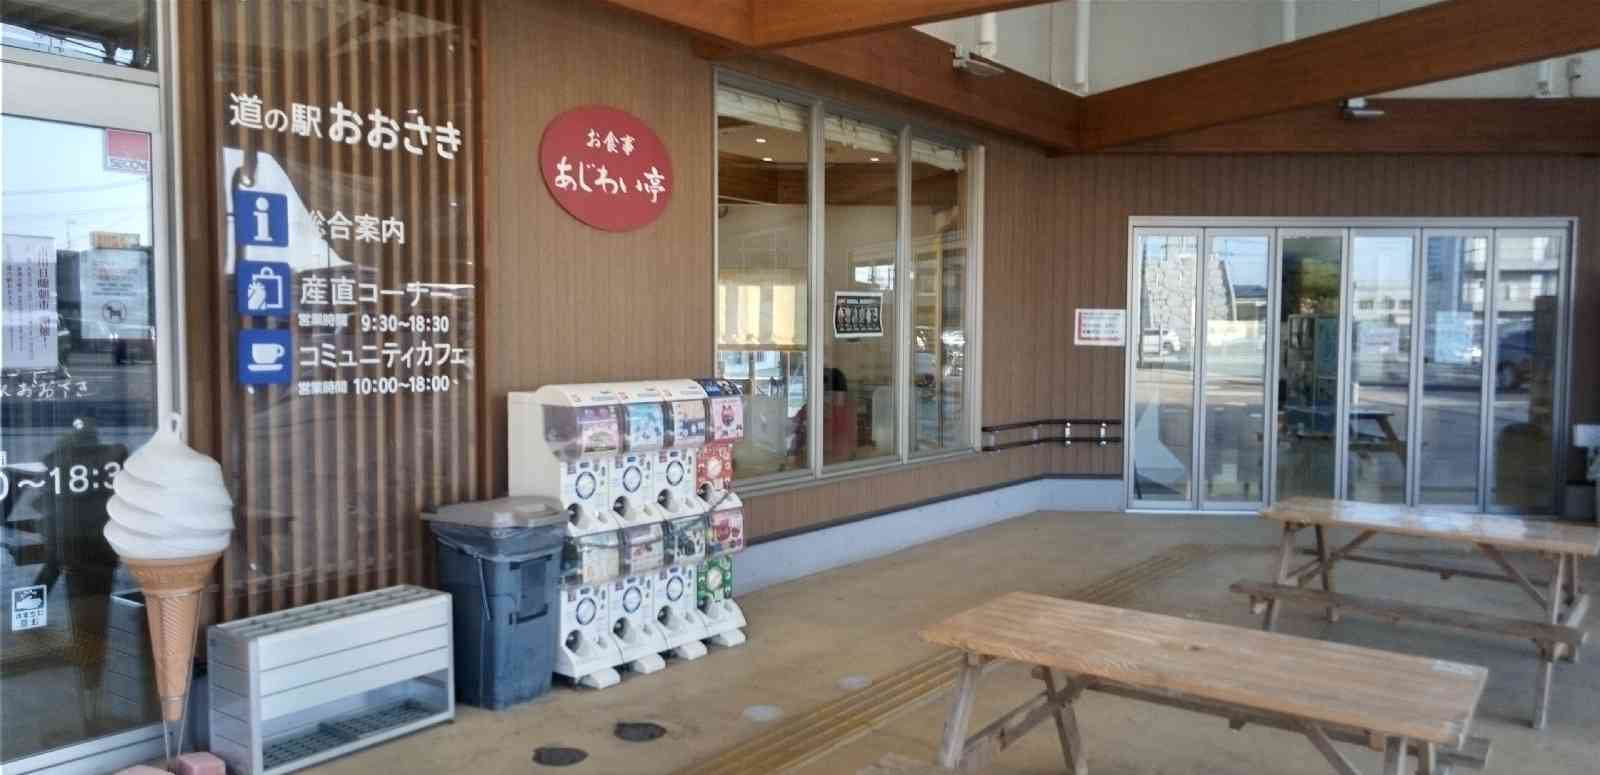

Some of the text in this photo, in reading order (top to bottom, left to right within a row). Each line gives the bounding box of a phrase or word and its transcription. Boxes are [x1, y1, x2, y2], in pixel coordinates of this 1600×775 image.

[229, 92, 463, 160] 道の駅おおさき
[586, 127, 636, 156] お食事
[554, 155, 666, 204] あじわい亭
[300, 274, 456, 307] 産直コーナー
[299, 340, 466, 369] コミュニティカフェ
